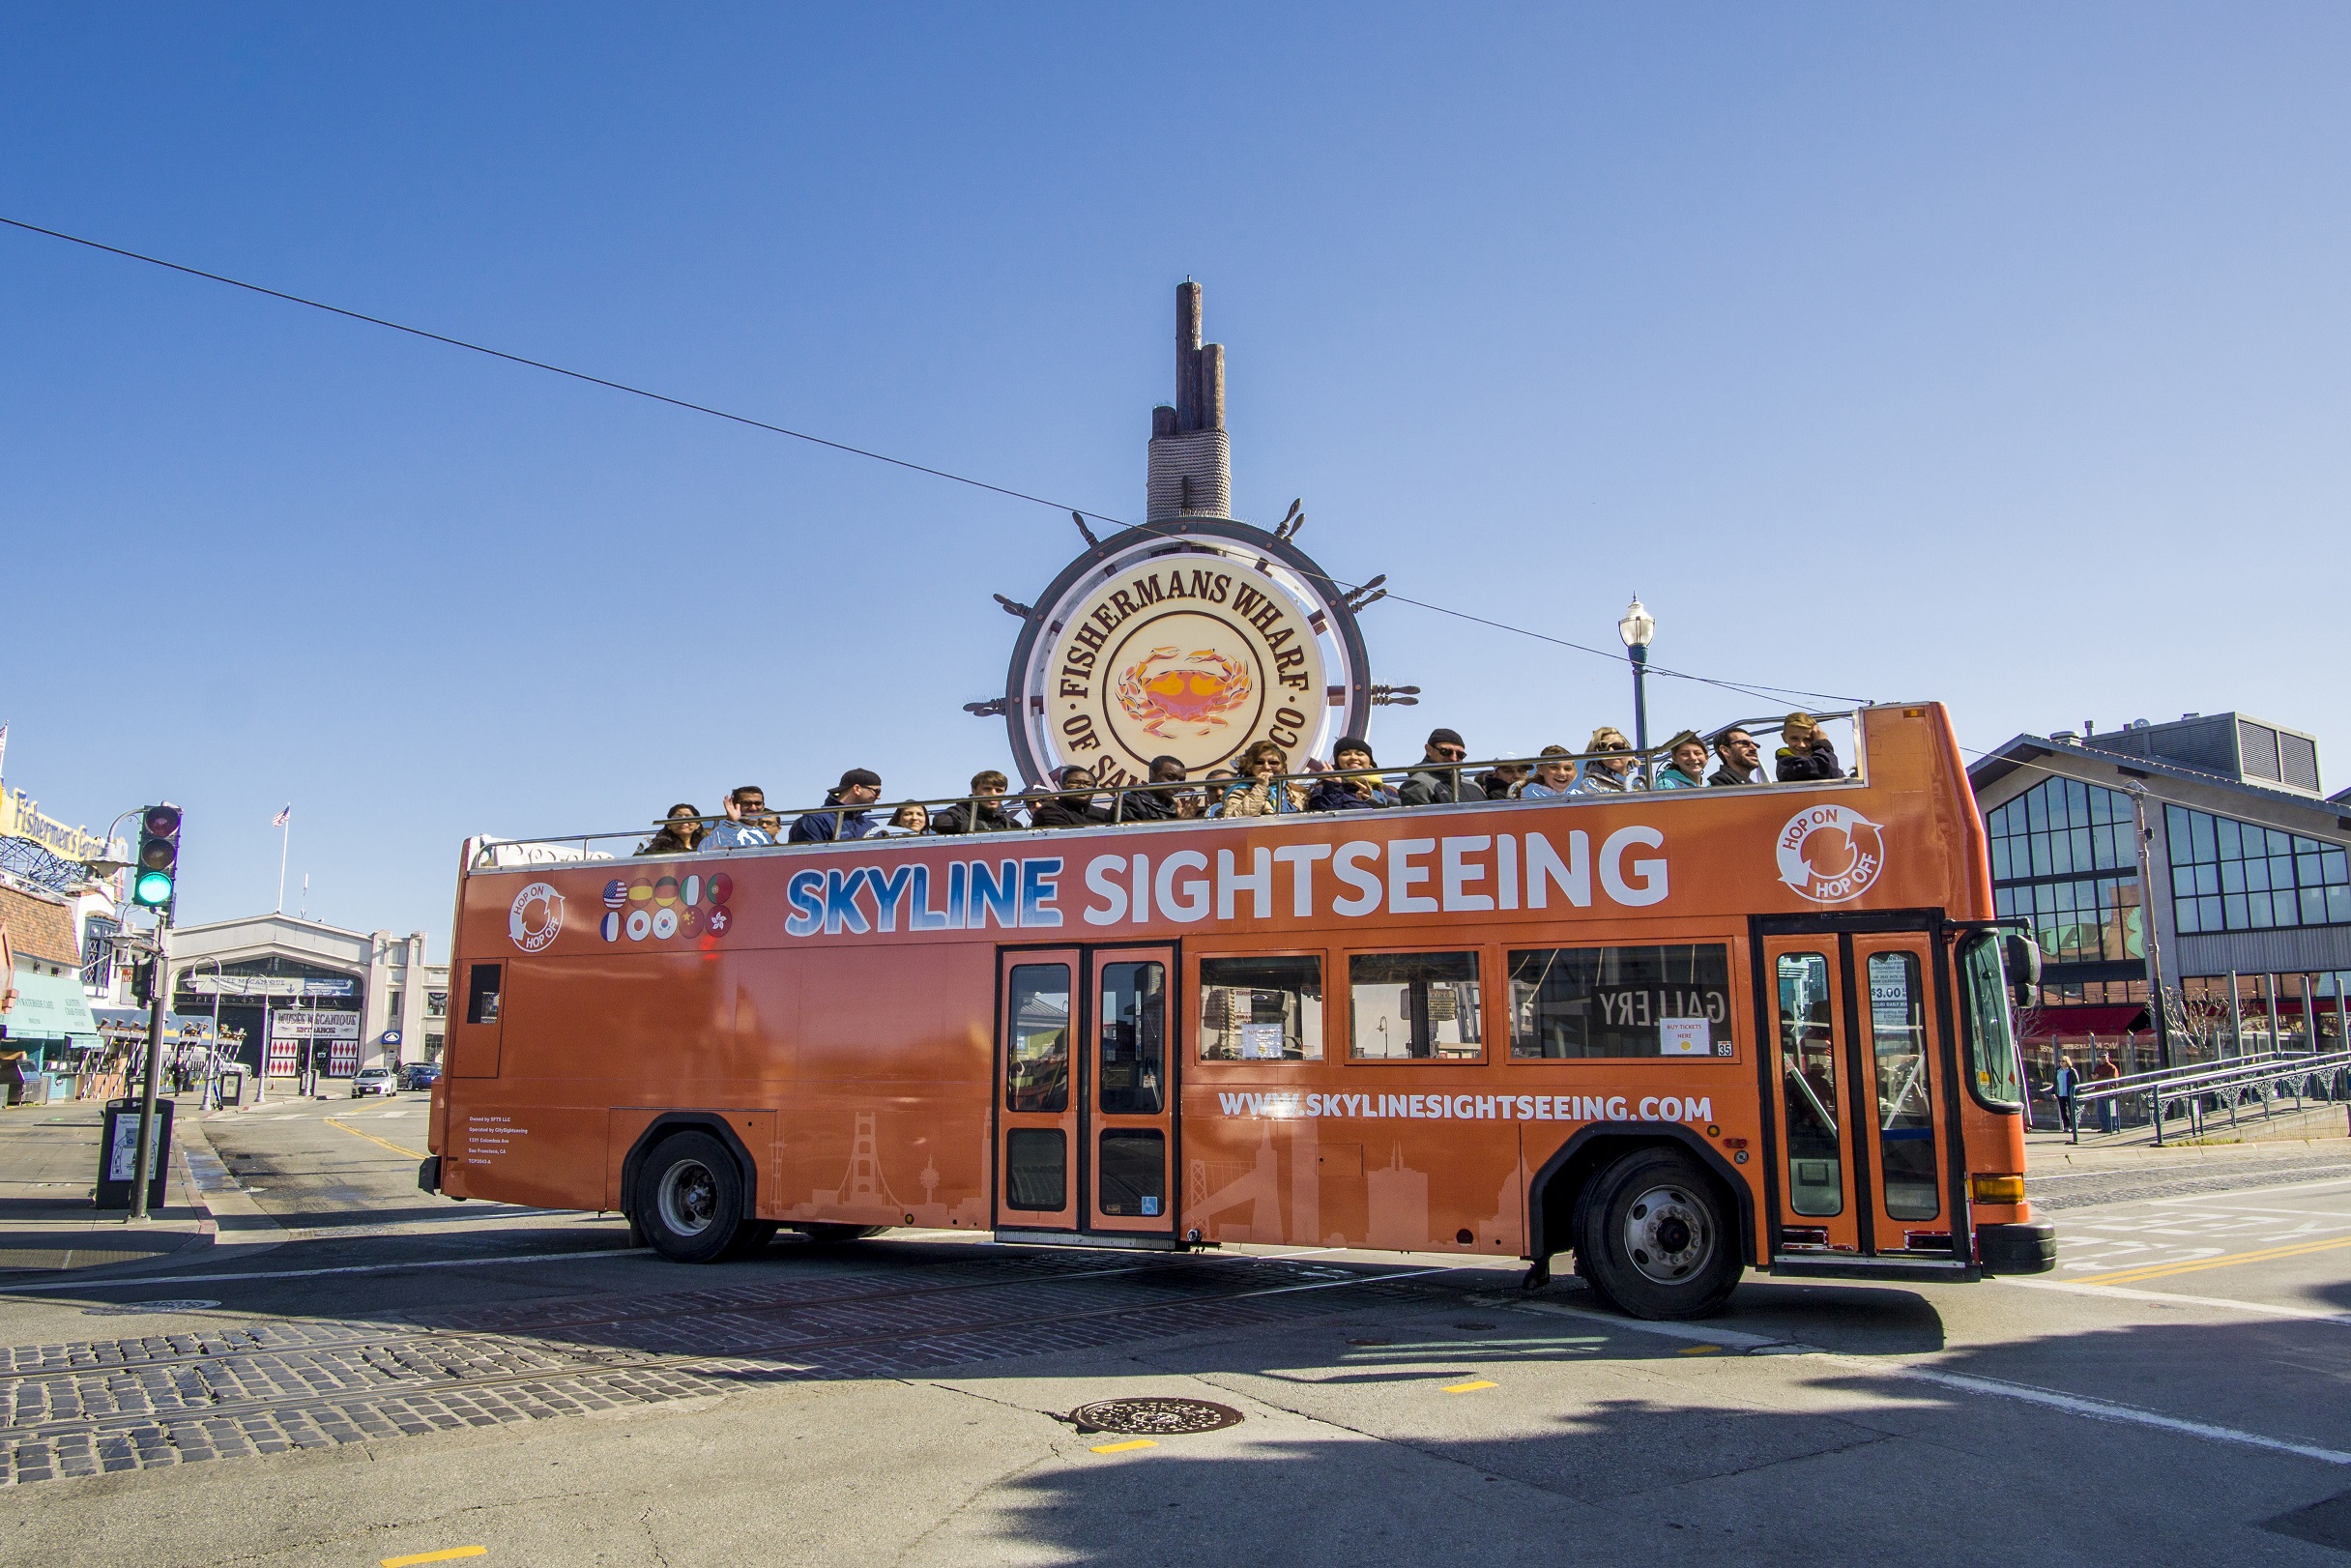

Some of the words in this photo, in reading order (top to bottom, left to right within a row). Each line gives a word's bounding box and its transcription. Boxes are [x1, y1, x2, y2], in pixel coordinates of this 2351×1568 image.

[1059, 568, 1232, 699] FISHERMANS
[1232, 582, 1310, 691] WHARF
[1063, 713, 1101, 752] OF
[1782, 818, 1809, 851] HOP
[1811, 808, 1838, 824] ON
[784, 857, 1064, 937] SKYLINE
[1083, 826, 1669, 926] SIGHTSEEING
[1815, 877, 1851, 898] HOP
[1851, 852, 1877, 884] OFF
[513, 892, 529, 915] HOP
[530, 886, 544, 897] ON
[526, 934, 544, 948] HOP
[545, 916, 560, 938] OFF
[1719, 1045, 1731, 1056] 35
[1218, 1092, 1713, 1122] WWW.SKYLINESIGHTSEEING.COM
